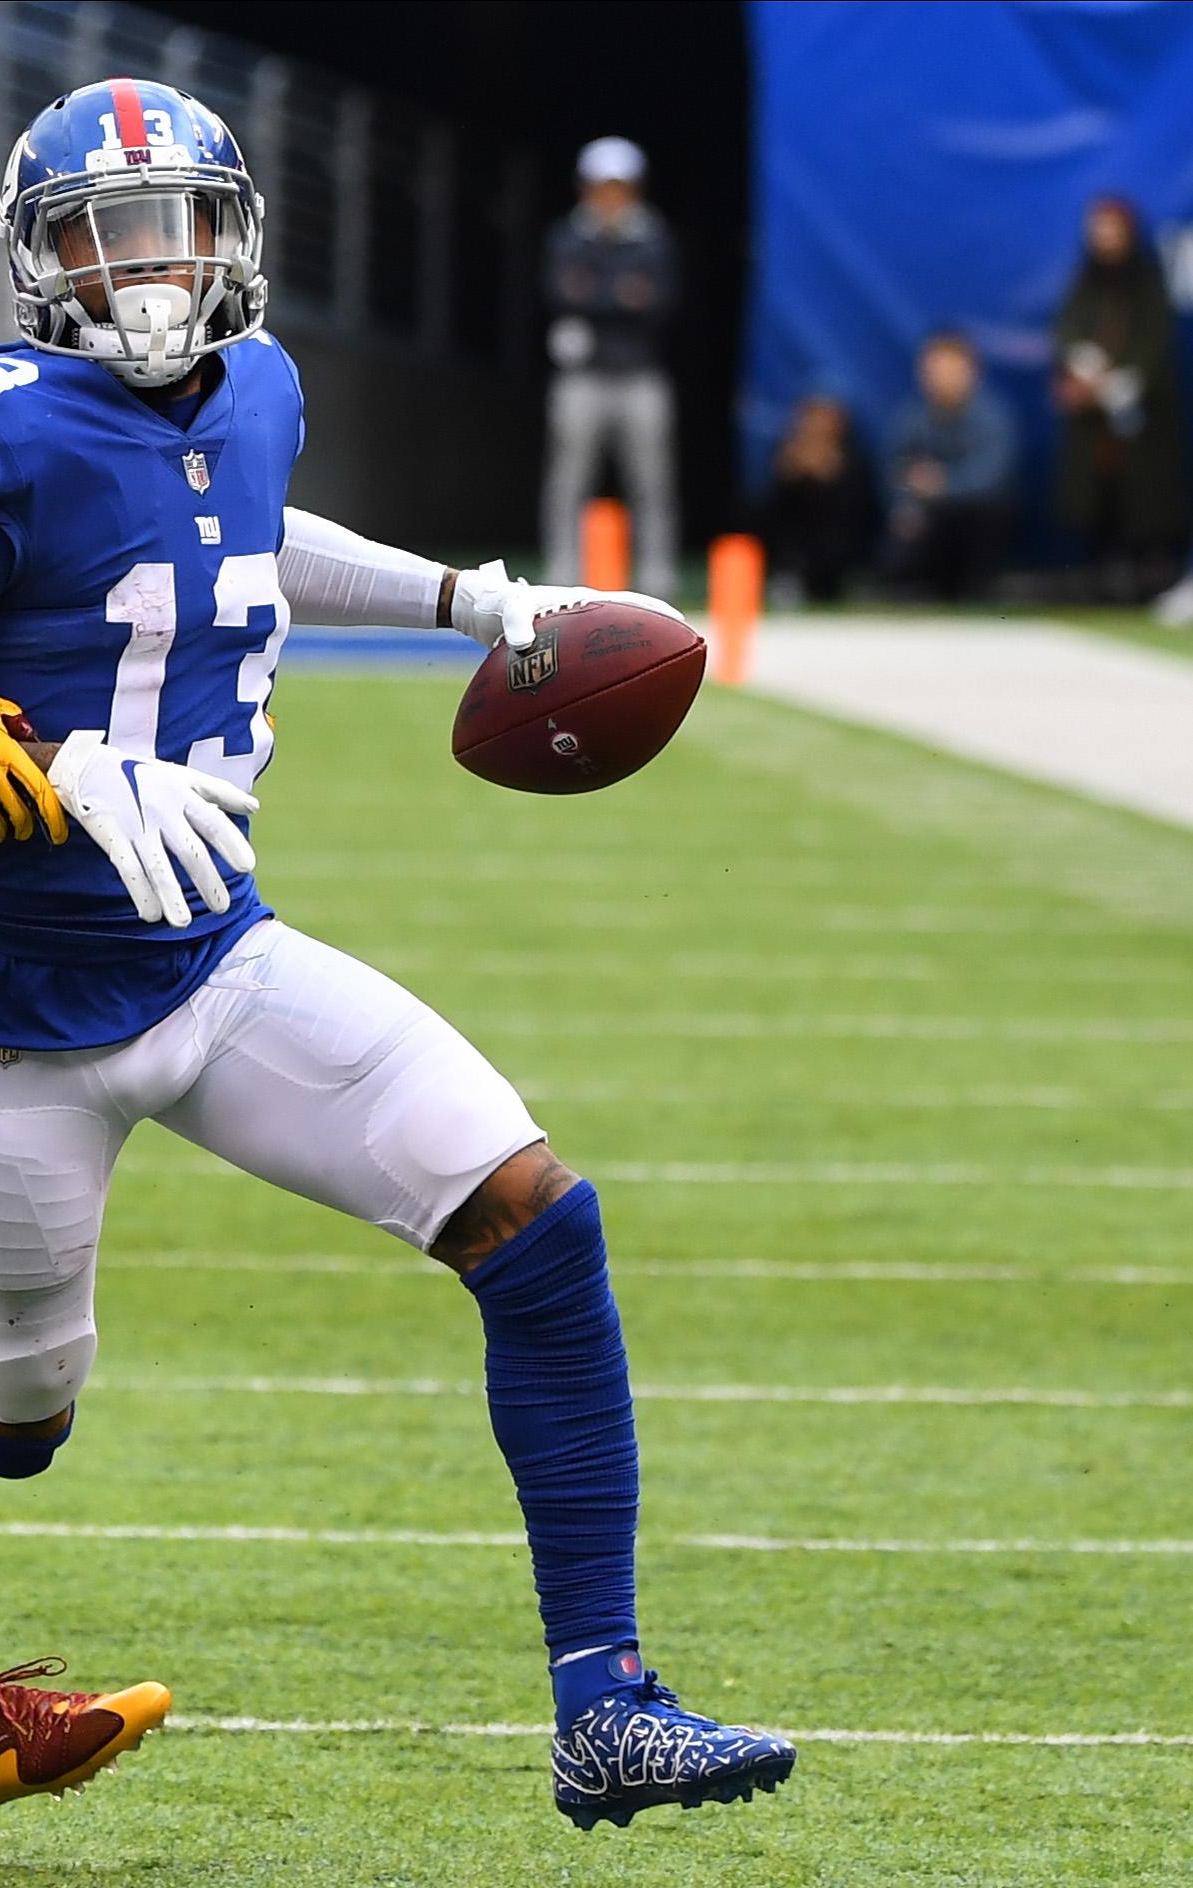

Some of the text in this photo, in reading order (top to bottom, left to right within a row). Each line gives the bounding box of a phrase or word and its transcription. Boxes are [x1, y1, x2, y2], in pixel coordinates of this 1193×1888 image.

[99, 109, 174, 149] 13
[106, 551, 291, 795] 13
[511, 651, 552, 688] NFL
